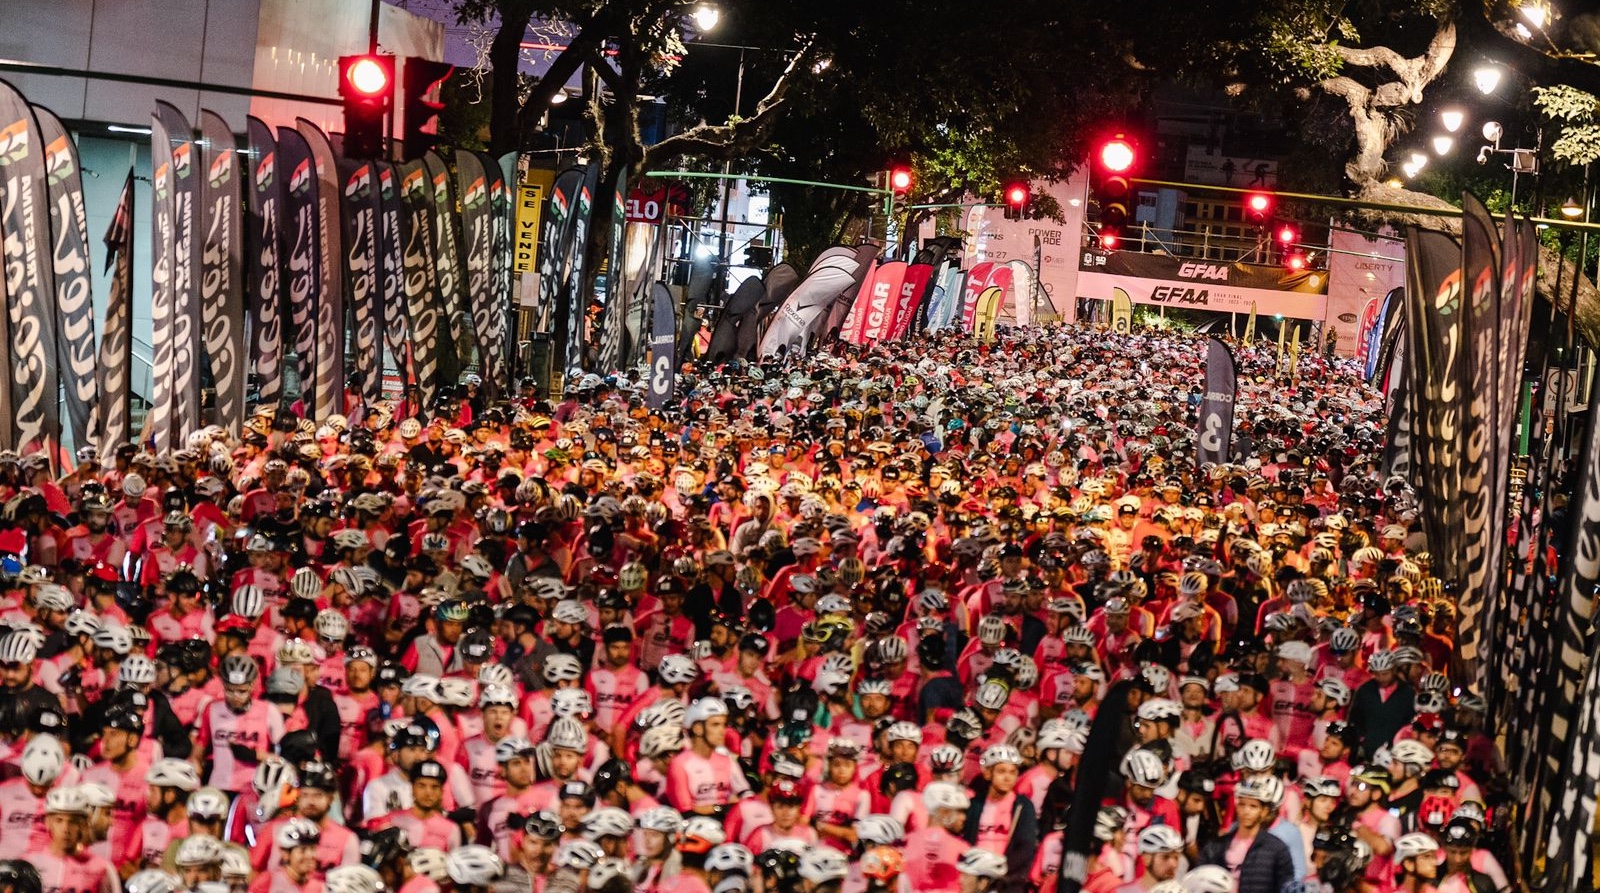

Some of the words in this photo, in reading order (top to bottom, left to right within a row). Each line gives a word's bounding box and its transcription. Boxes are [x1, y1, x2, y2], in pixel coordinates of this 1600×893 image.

[524, 190, 536, 208] SE
[1028, 228, 1061, 238] POWER
[1043, 237, 1061, 246] ADE
[518, 221, 534, 271] VENDE
[996, 251, 1007, 259] 27
[1178, 262, 1228, 280] GFAA
[1150, 285, 1208, 305] GFAA
[784, 302, 806, 327] Rexona
[865, 281, 891, 339] AGAR
